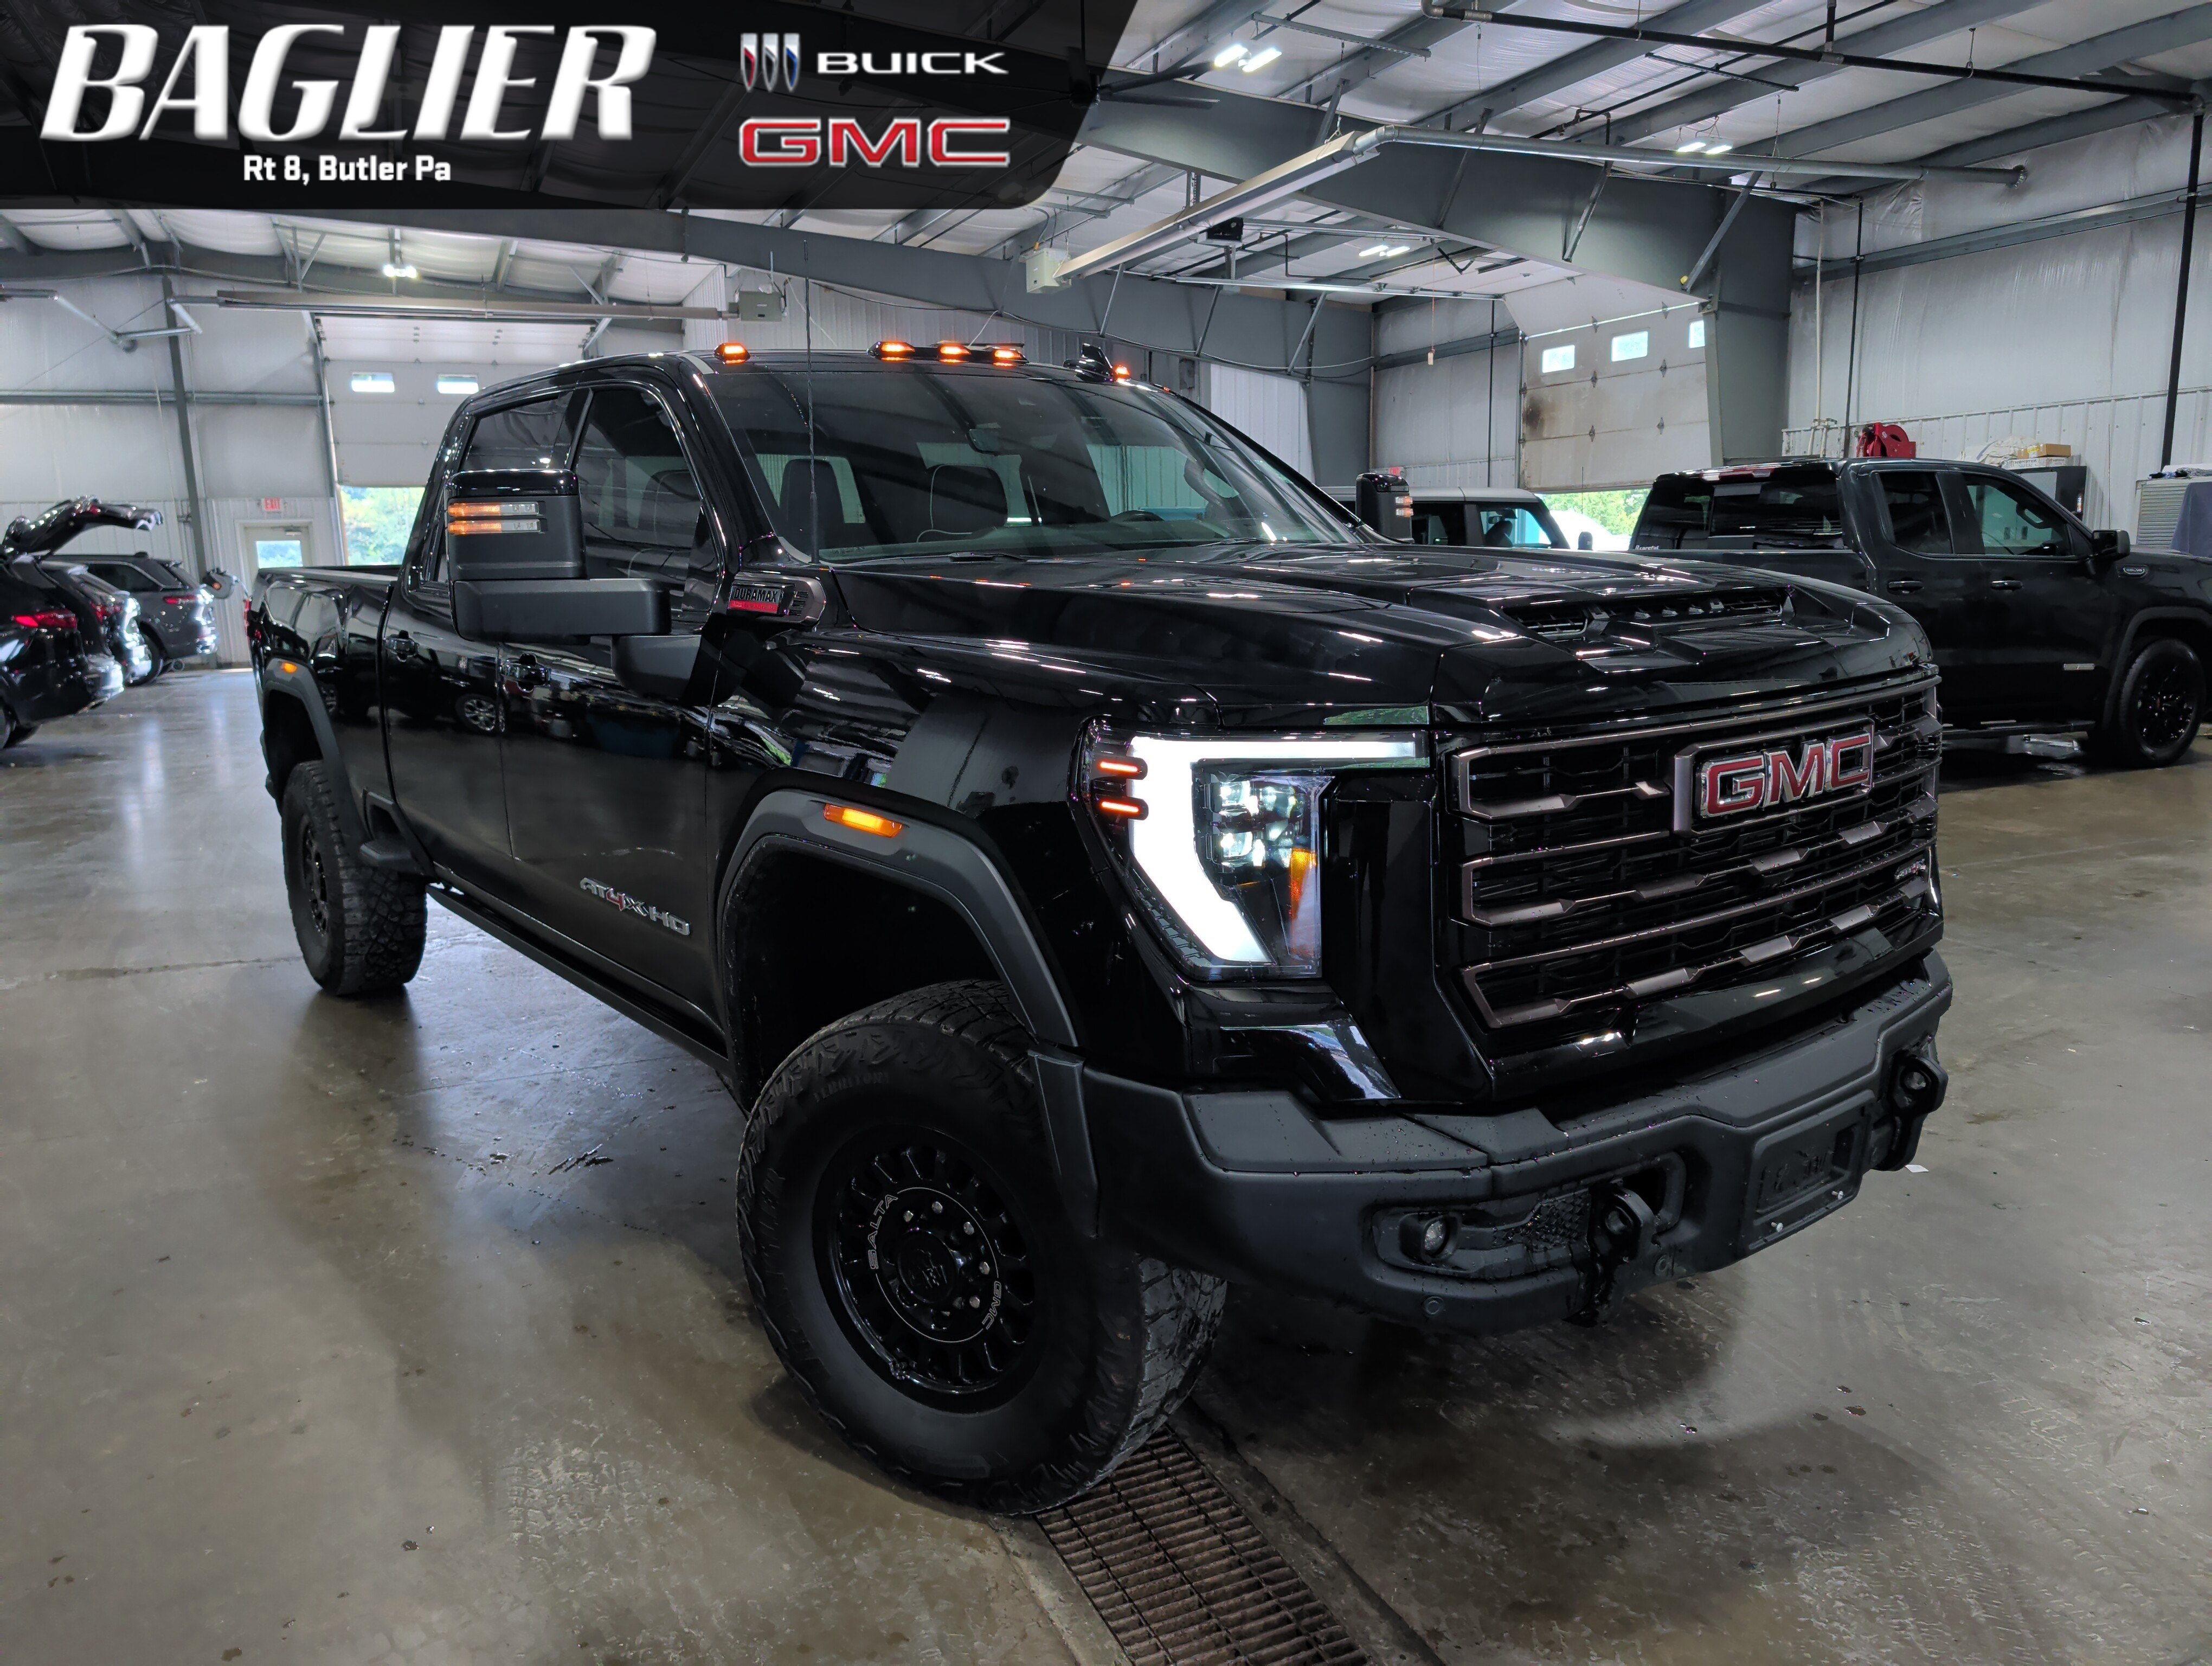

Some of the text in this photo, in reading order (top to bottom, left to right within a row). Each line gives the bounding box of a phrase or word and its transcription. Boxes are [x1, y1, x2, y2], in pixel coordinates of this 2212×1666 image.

[265, 498, 280, 510] EXIT
[733, 587, 778, 603] DURAMAX
[1700, 730, 1871, 819] GMC
[867, 1194, 898, 1270] SALTA
[982, 1280, 1002, 1330] GMC
